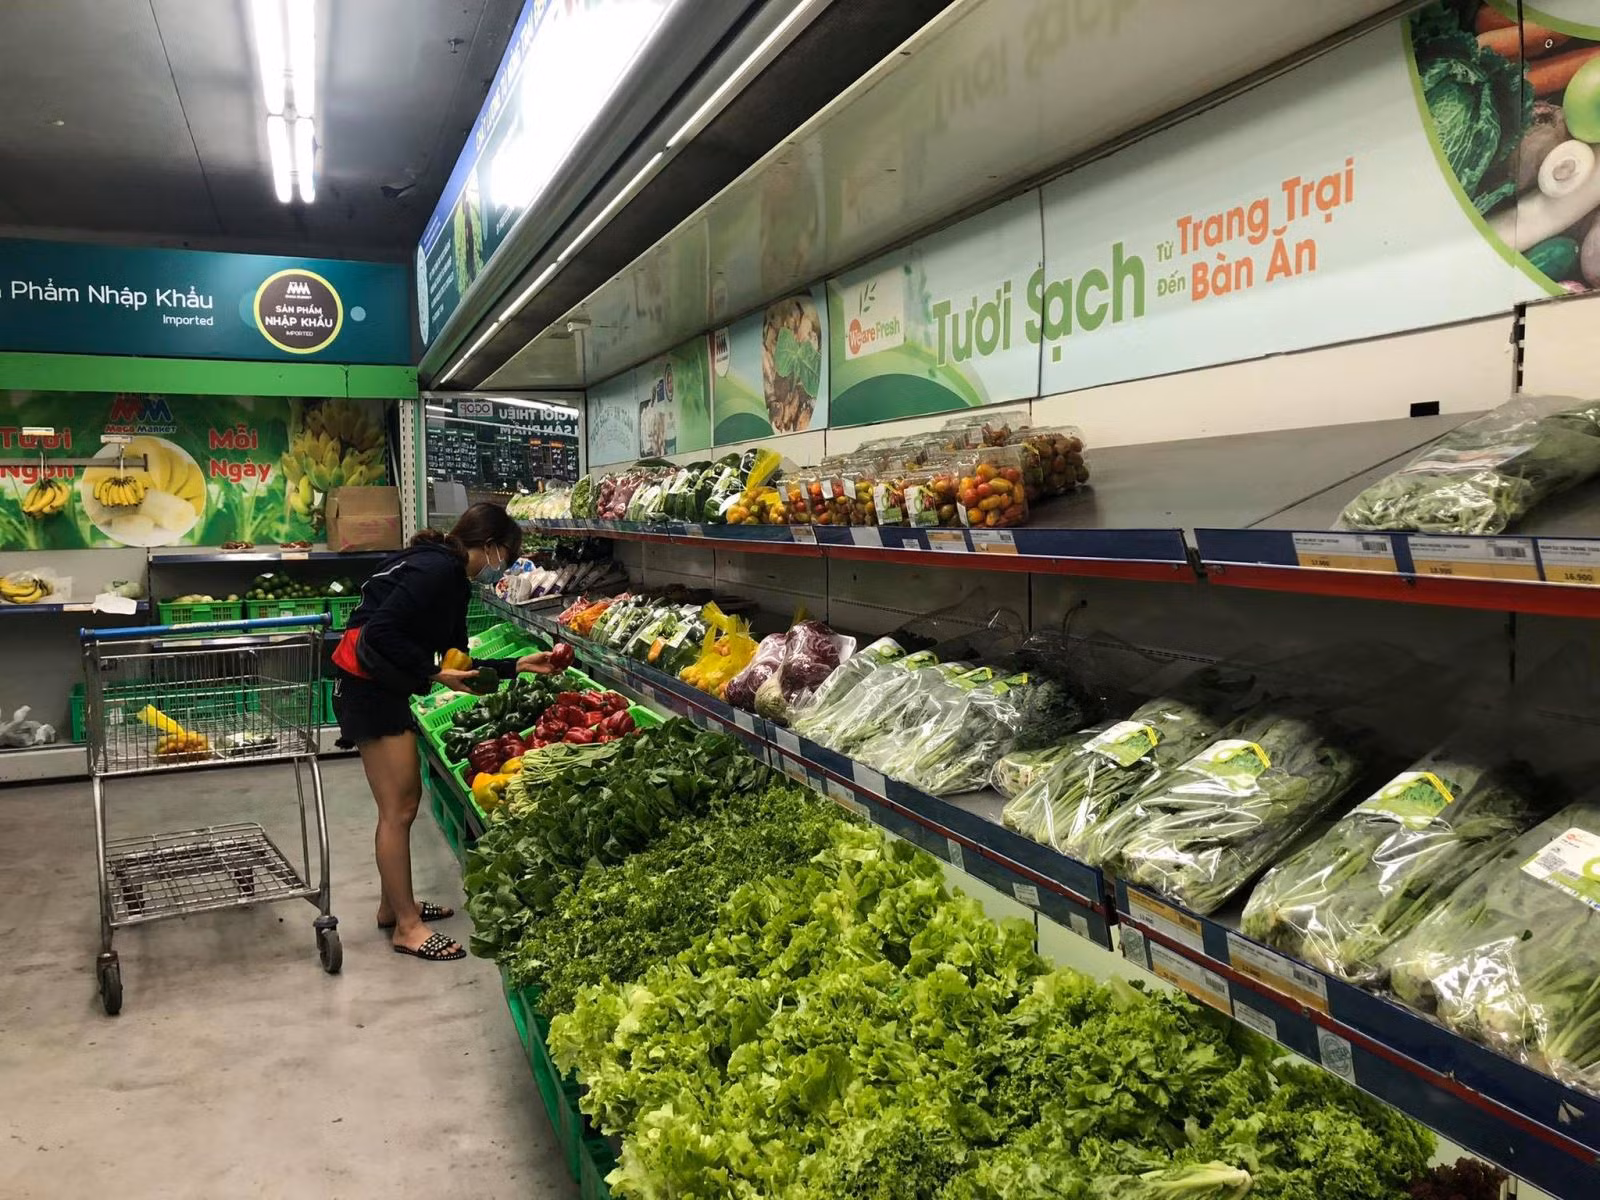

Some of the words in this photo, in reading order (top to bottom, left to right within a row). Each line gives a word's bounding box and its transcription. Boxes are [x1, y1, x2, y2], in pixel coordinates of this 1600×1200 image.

[1156, 241, 1174, 262] Từ
[1176, 197, 1269, 255] Trang
[1281, 157, 1354, 224] Trại
[1157, 270, 1186, 297] Đến
[1191, 252, 1253, 302] Bàn
[1265, 225, 1316, 283] Ăn
[11, 277, 79, 303] Phẩm
[88, 285, 147, 311] Nhập
[155, 285, 213, 309] Khẩu
[932, 279, 1012, 366] Tươi
[1025, 241, 1145, 363] Sạch
[162, 314, 214, 327] Imported
[264, 314, 298, 328] NHẬP
[209, 423, 258, 449] Mỗi
[209, 459, 272, 483] Ngày
